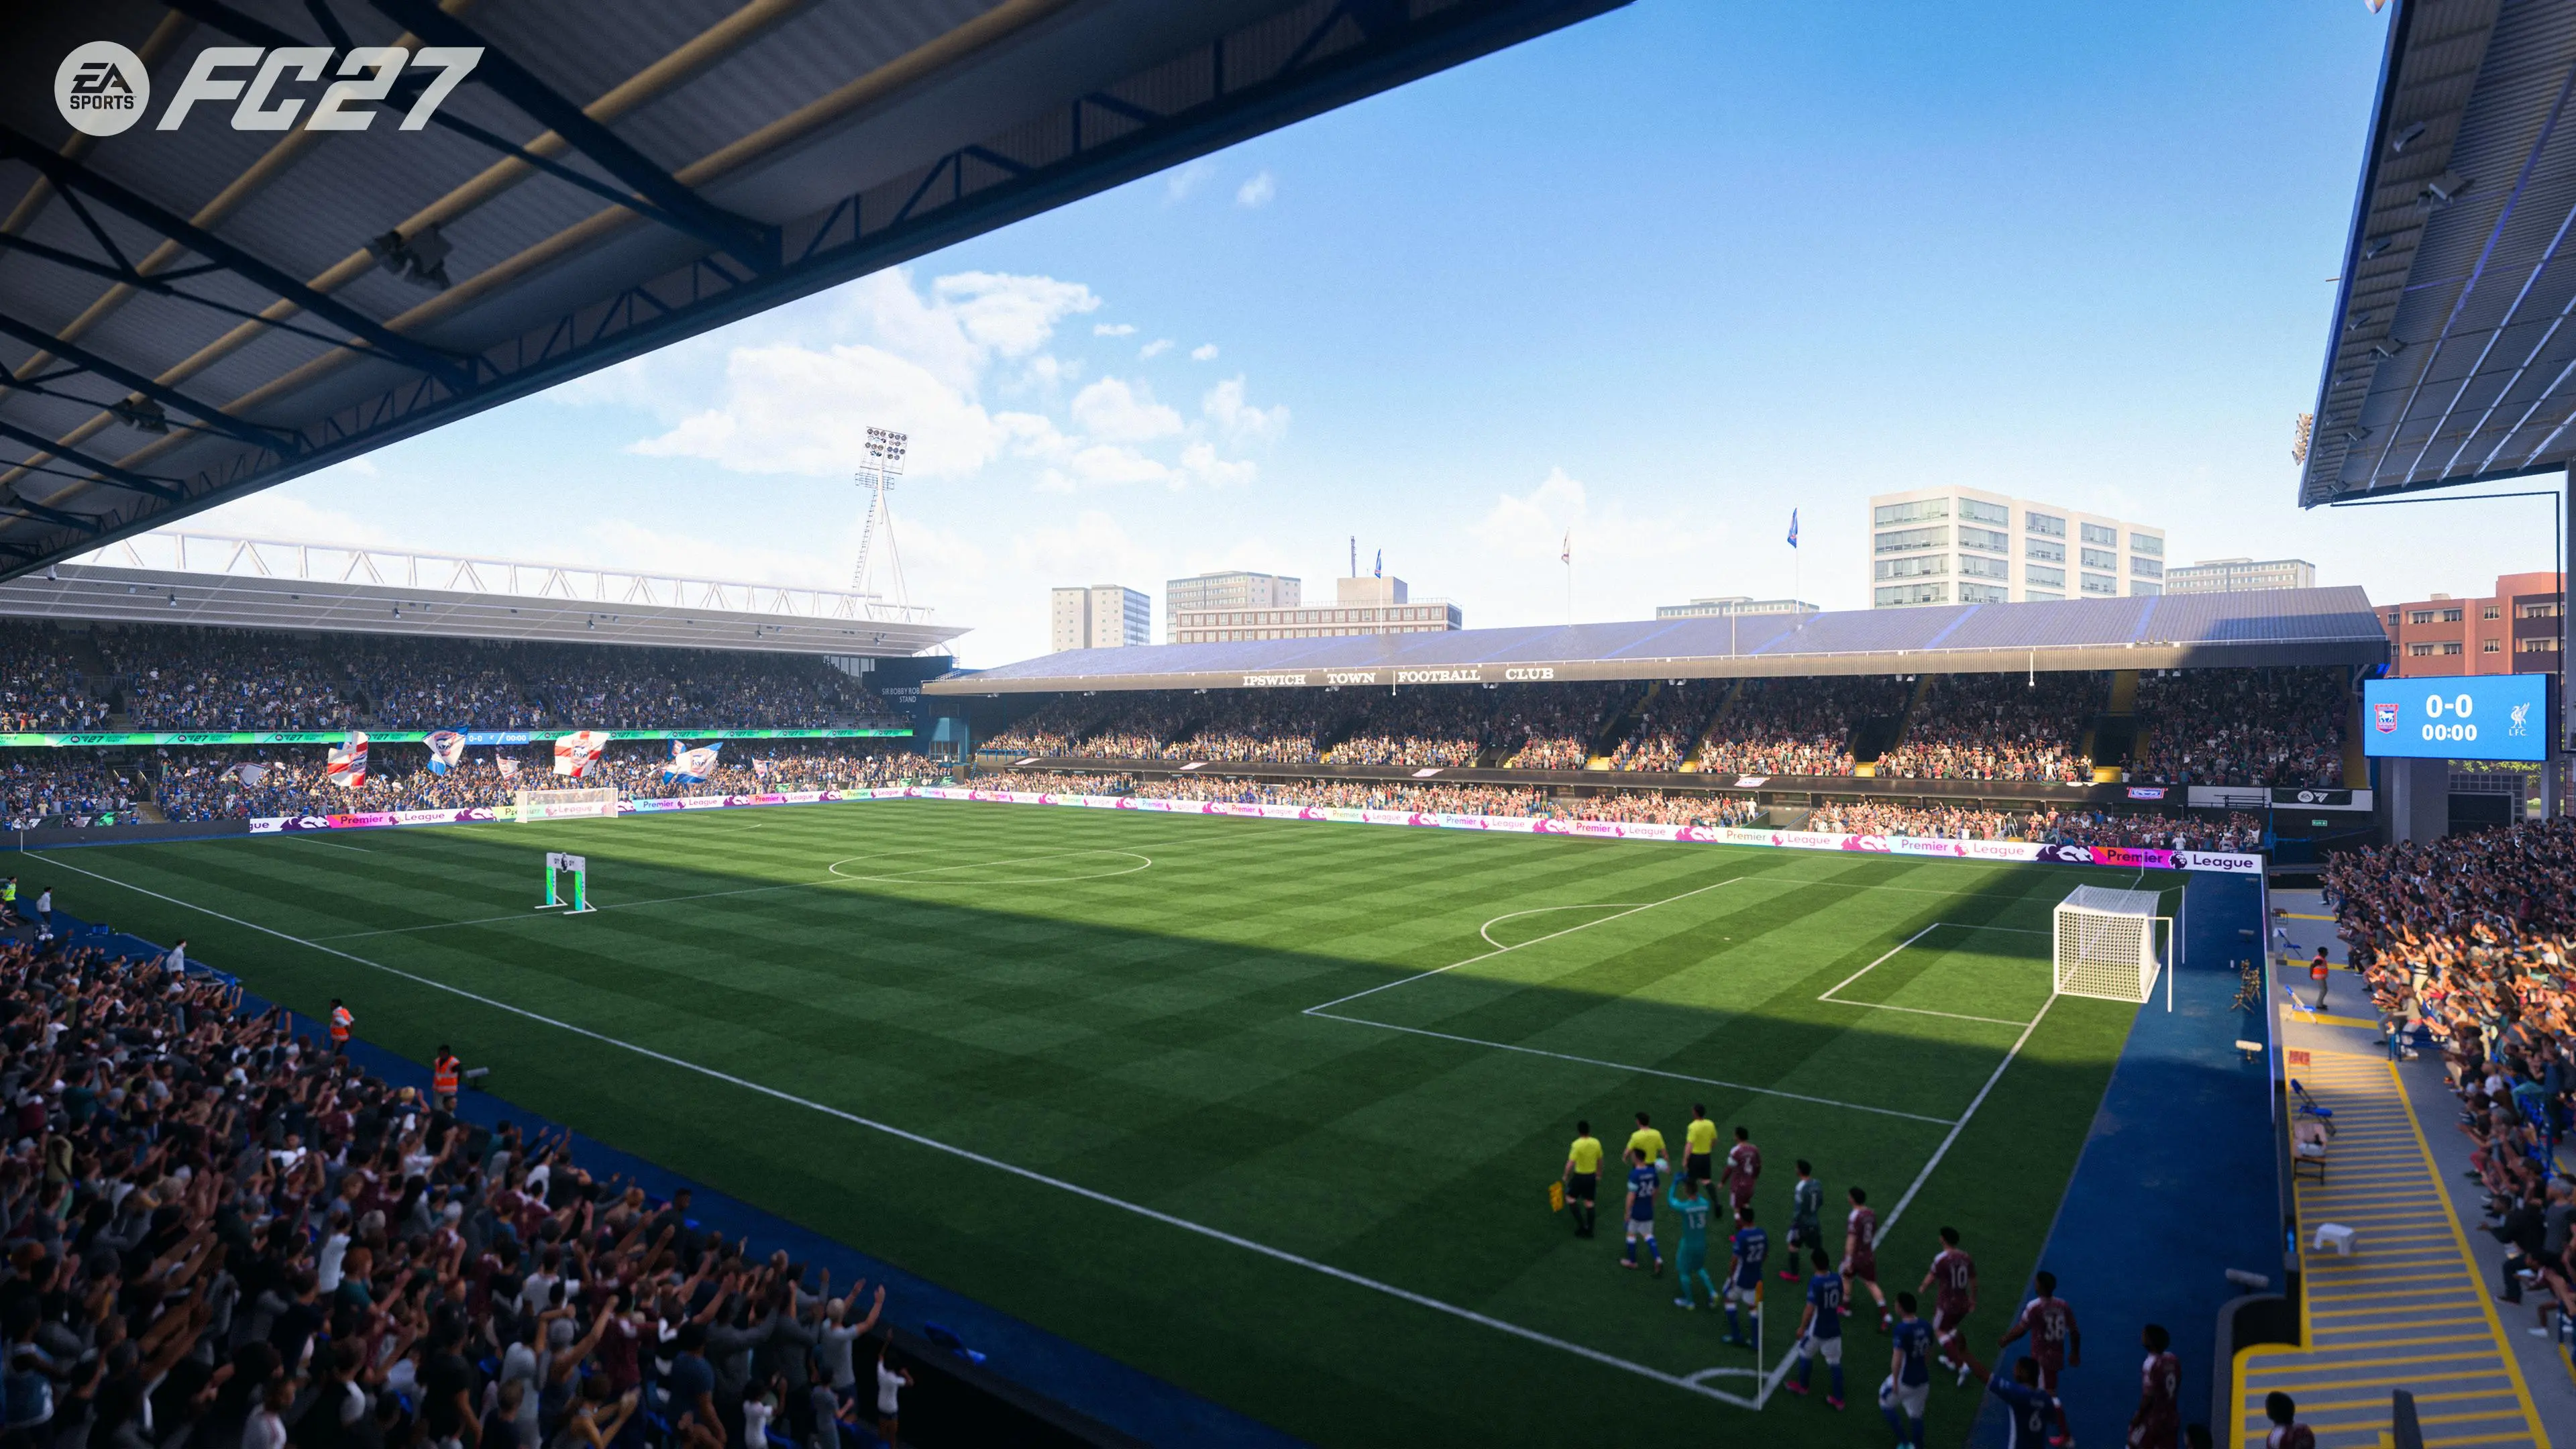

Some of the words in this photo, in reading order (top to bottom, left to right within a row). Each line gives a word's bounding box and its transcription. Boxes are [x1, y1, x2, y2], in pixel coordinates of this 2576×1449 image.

[1242, 674, 1306, 686] IPSWICH
[1327, 672, 1376, 684] TOWN
[1398, 669, 1481, 683] FOOTBALL
[1505, 667, 1554, 680] CLUB
[890, 687, 907, 695] BOBBY
[2426, 694, 2473, 718] 0-0
[2422, 724, 2477, 741] 00:00
[643, 800, 674, 808] Premier
[689, 798, 717, 806] League
[755, 795, 779, 803] Premier
[790, 794, 814, 802] League
[1142, 800, 1163, 808] Premier
[1232, 805, 1255, 814] Premier
[1332, 810, 1359, 818] Premier
[1373, 812, 1401, 822] League
[250, 821, 270, 831] gue
[340, 815, 384, 825] Premier
[405, 812, 445, 822] League
[1446, 815, 1476, 825] Premier
[1493, 818, 1525, 828] League
[1576, 822, 1611, 833] Premier
[1629, 826, 1666, 837] League
[1727, 830, 1766, 842] Premier
[1787, 833, 1831, 845] League
[1901, 839, 1948, 851] Premier
[1974, 843, 2025, 857] League
[2107, 850, 2163, 864] Premier
[2193, 854, 2254, 871] League
[1688, 1213, 1707, 1230] 13
[1949, 1265, 1969, 1290] 10
[1823, 1289, 1840, 1309] 10
[2028, 1410, 2042, 1432] 6
